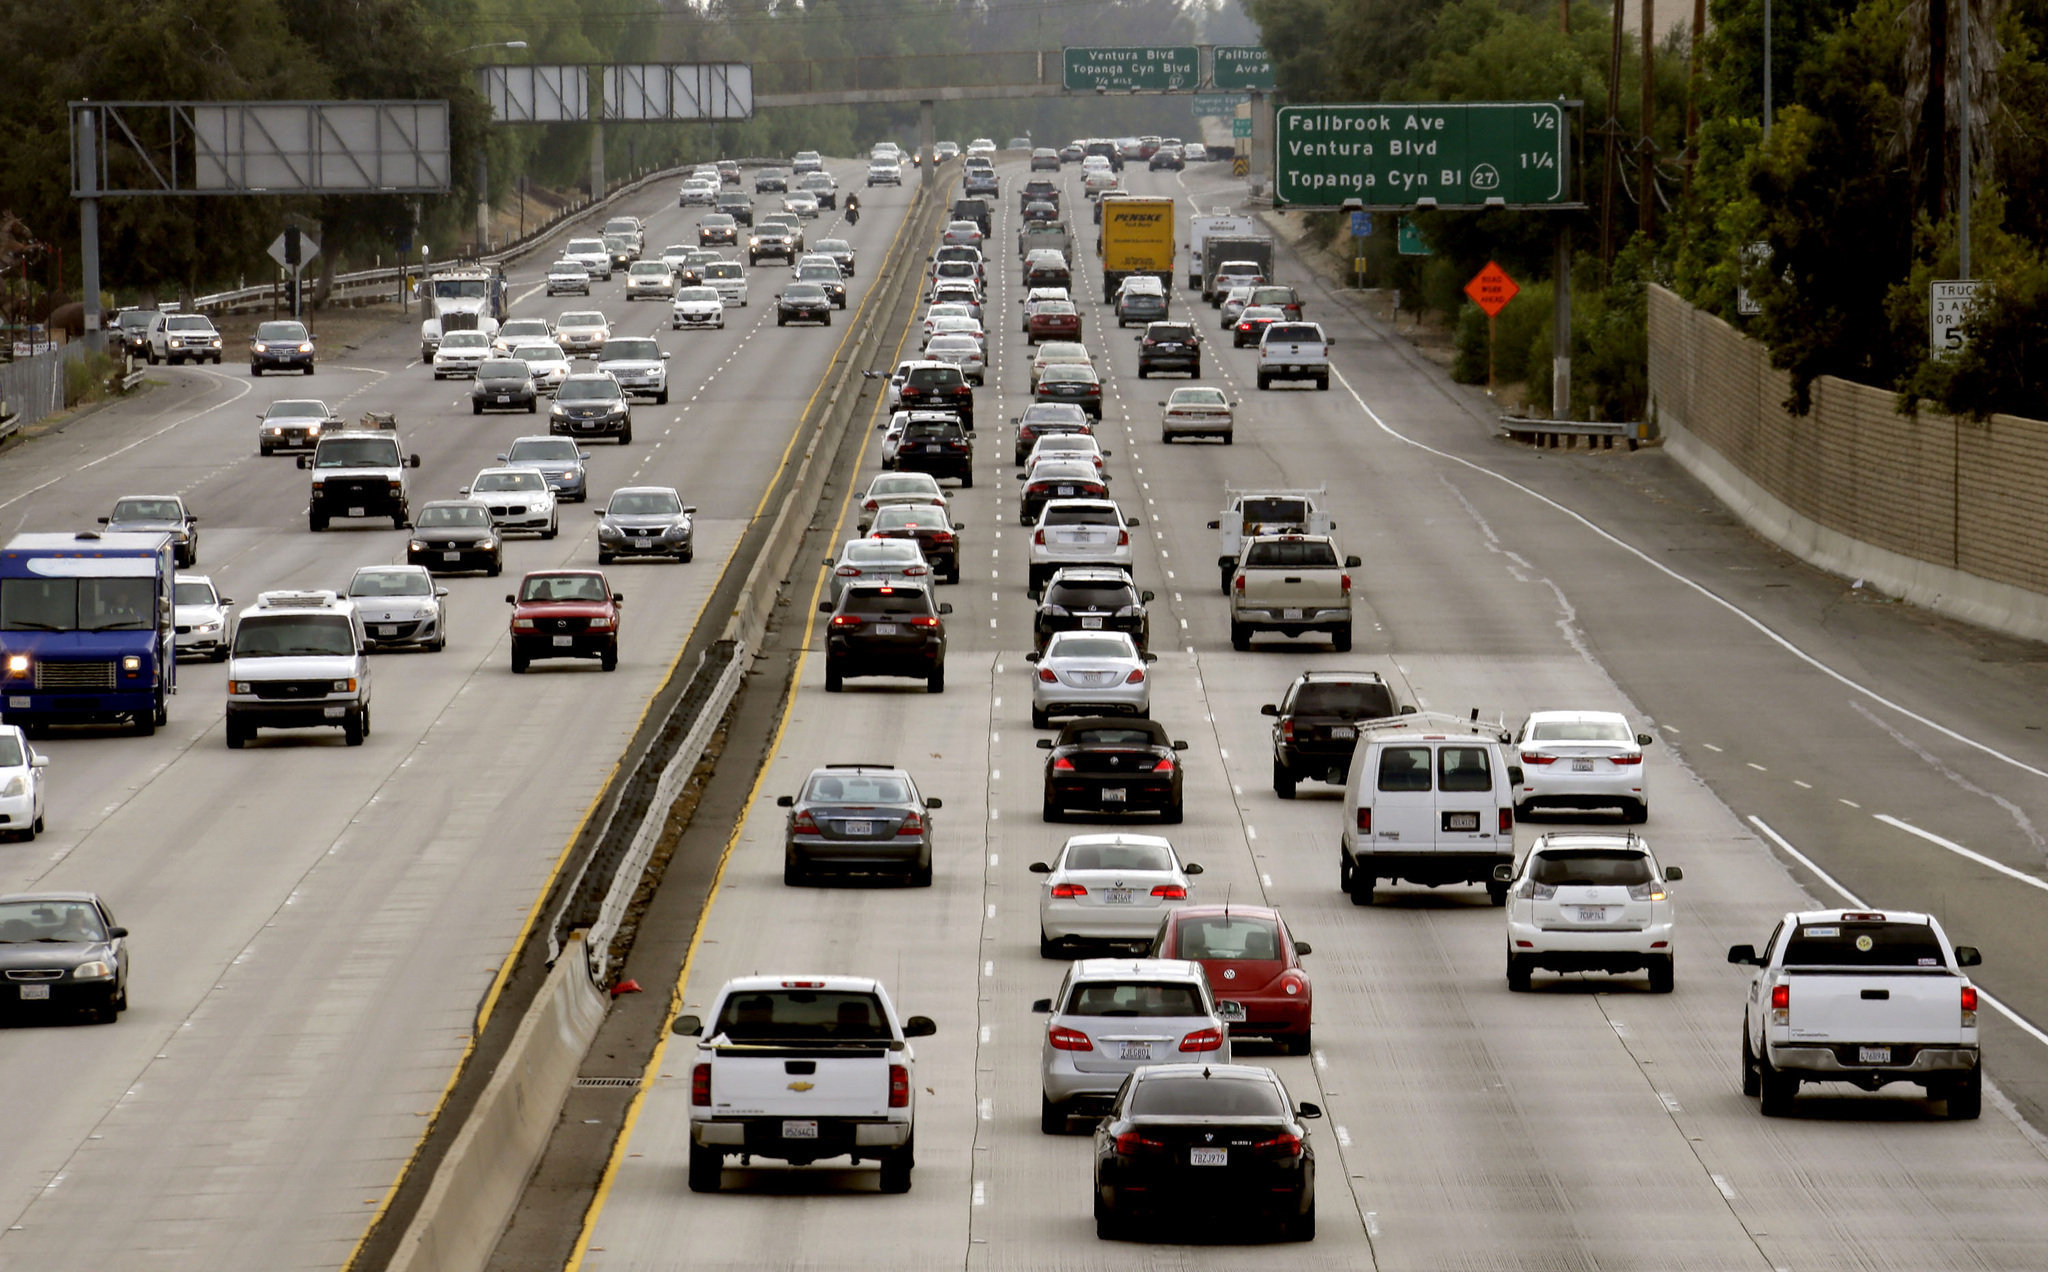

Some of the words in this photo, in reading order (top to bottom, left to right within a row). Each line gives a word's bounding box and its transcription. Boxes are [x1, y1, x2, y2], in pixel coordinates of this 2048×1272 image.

[1088, 51, 1138, 60] Ventura
[1147, 50, 1175, 60] Blvd
[1217, 50, 1268, 60] Fallbroo
[1072, 64, 1123, 76] Topanga
[1131, 64, 1154, 76] Cyn
[1163, 63, 1191, 73] Blvd
[1235, 64, 1258, 73] Ave
[1289, 115, 1391, 131] Fallbrook
[1404, 115, 1445, 131] Ave
[1289, 141, 1373, 155] Ventura
[1390, 140, 1437, 155] Blvd
[1288, 171, 1376, 191] Topanga
[1388, 170, 1428, 191] Cyn
[1441, 170, 1462, 185] Bl
[1474, 172, 1494, 185] 27
[1114, 214, 1163, 222] PENSKE
[1941, 286, 1977, 296] TRUC
[1938, 302, 1944, 311] 3
[1936, 315, 1952, 324] OR
[1193, 1153, 1225, 1164] 7BZJ979
